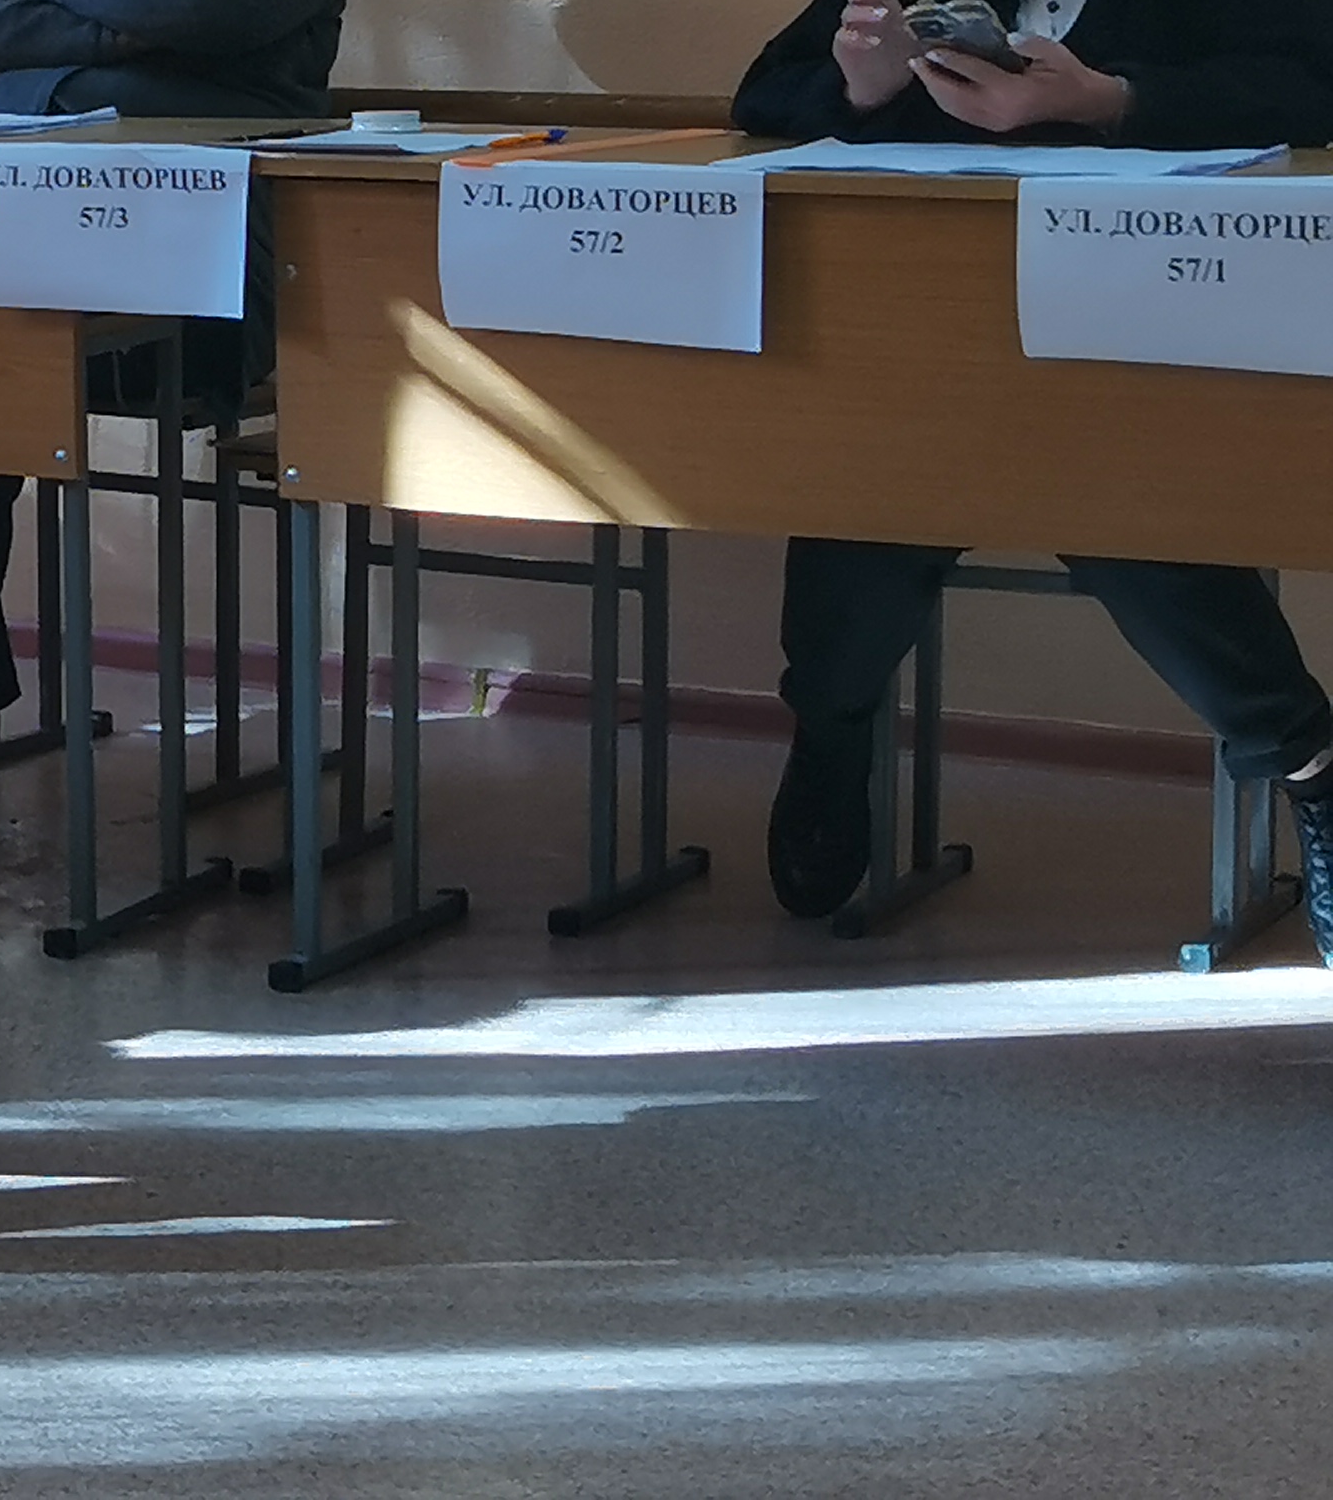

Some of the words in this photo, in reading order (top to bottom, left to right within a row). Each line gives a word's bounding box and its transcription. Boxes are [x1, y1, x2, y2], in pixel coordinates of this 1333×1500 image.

[33, 165, 228, 193] ДОВАТОРЦЕВ
[463, 183, 512, 207] УЛ.
[519, 185, 738, 219] ДОВАТОРЦЕВ
[78, 206, 129, 228] 57/3
[1044, 208, 1102, 233] УЛ.
[569, 230, 625, 254] 57/2
[1167, 257, 1226, 283] 57/1
